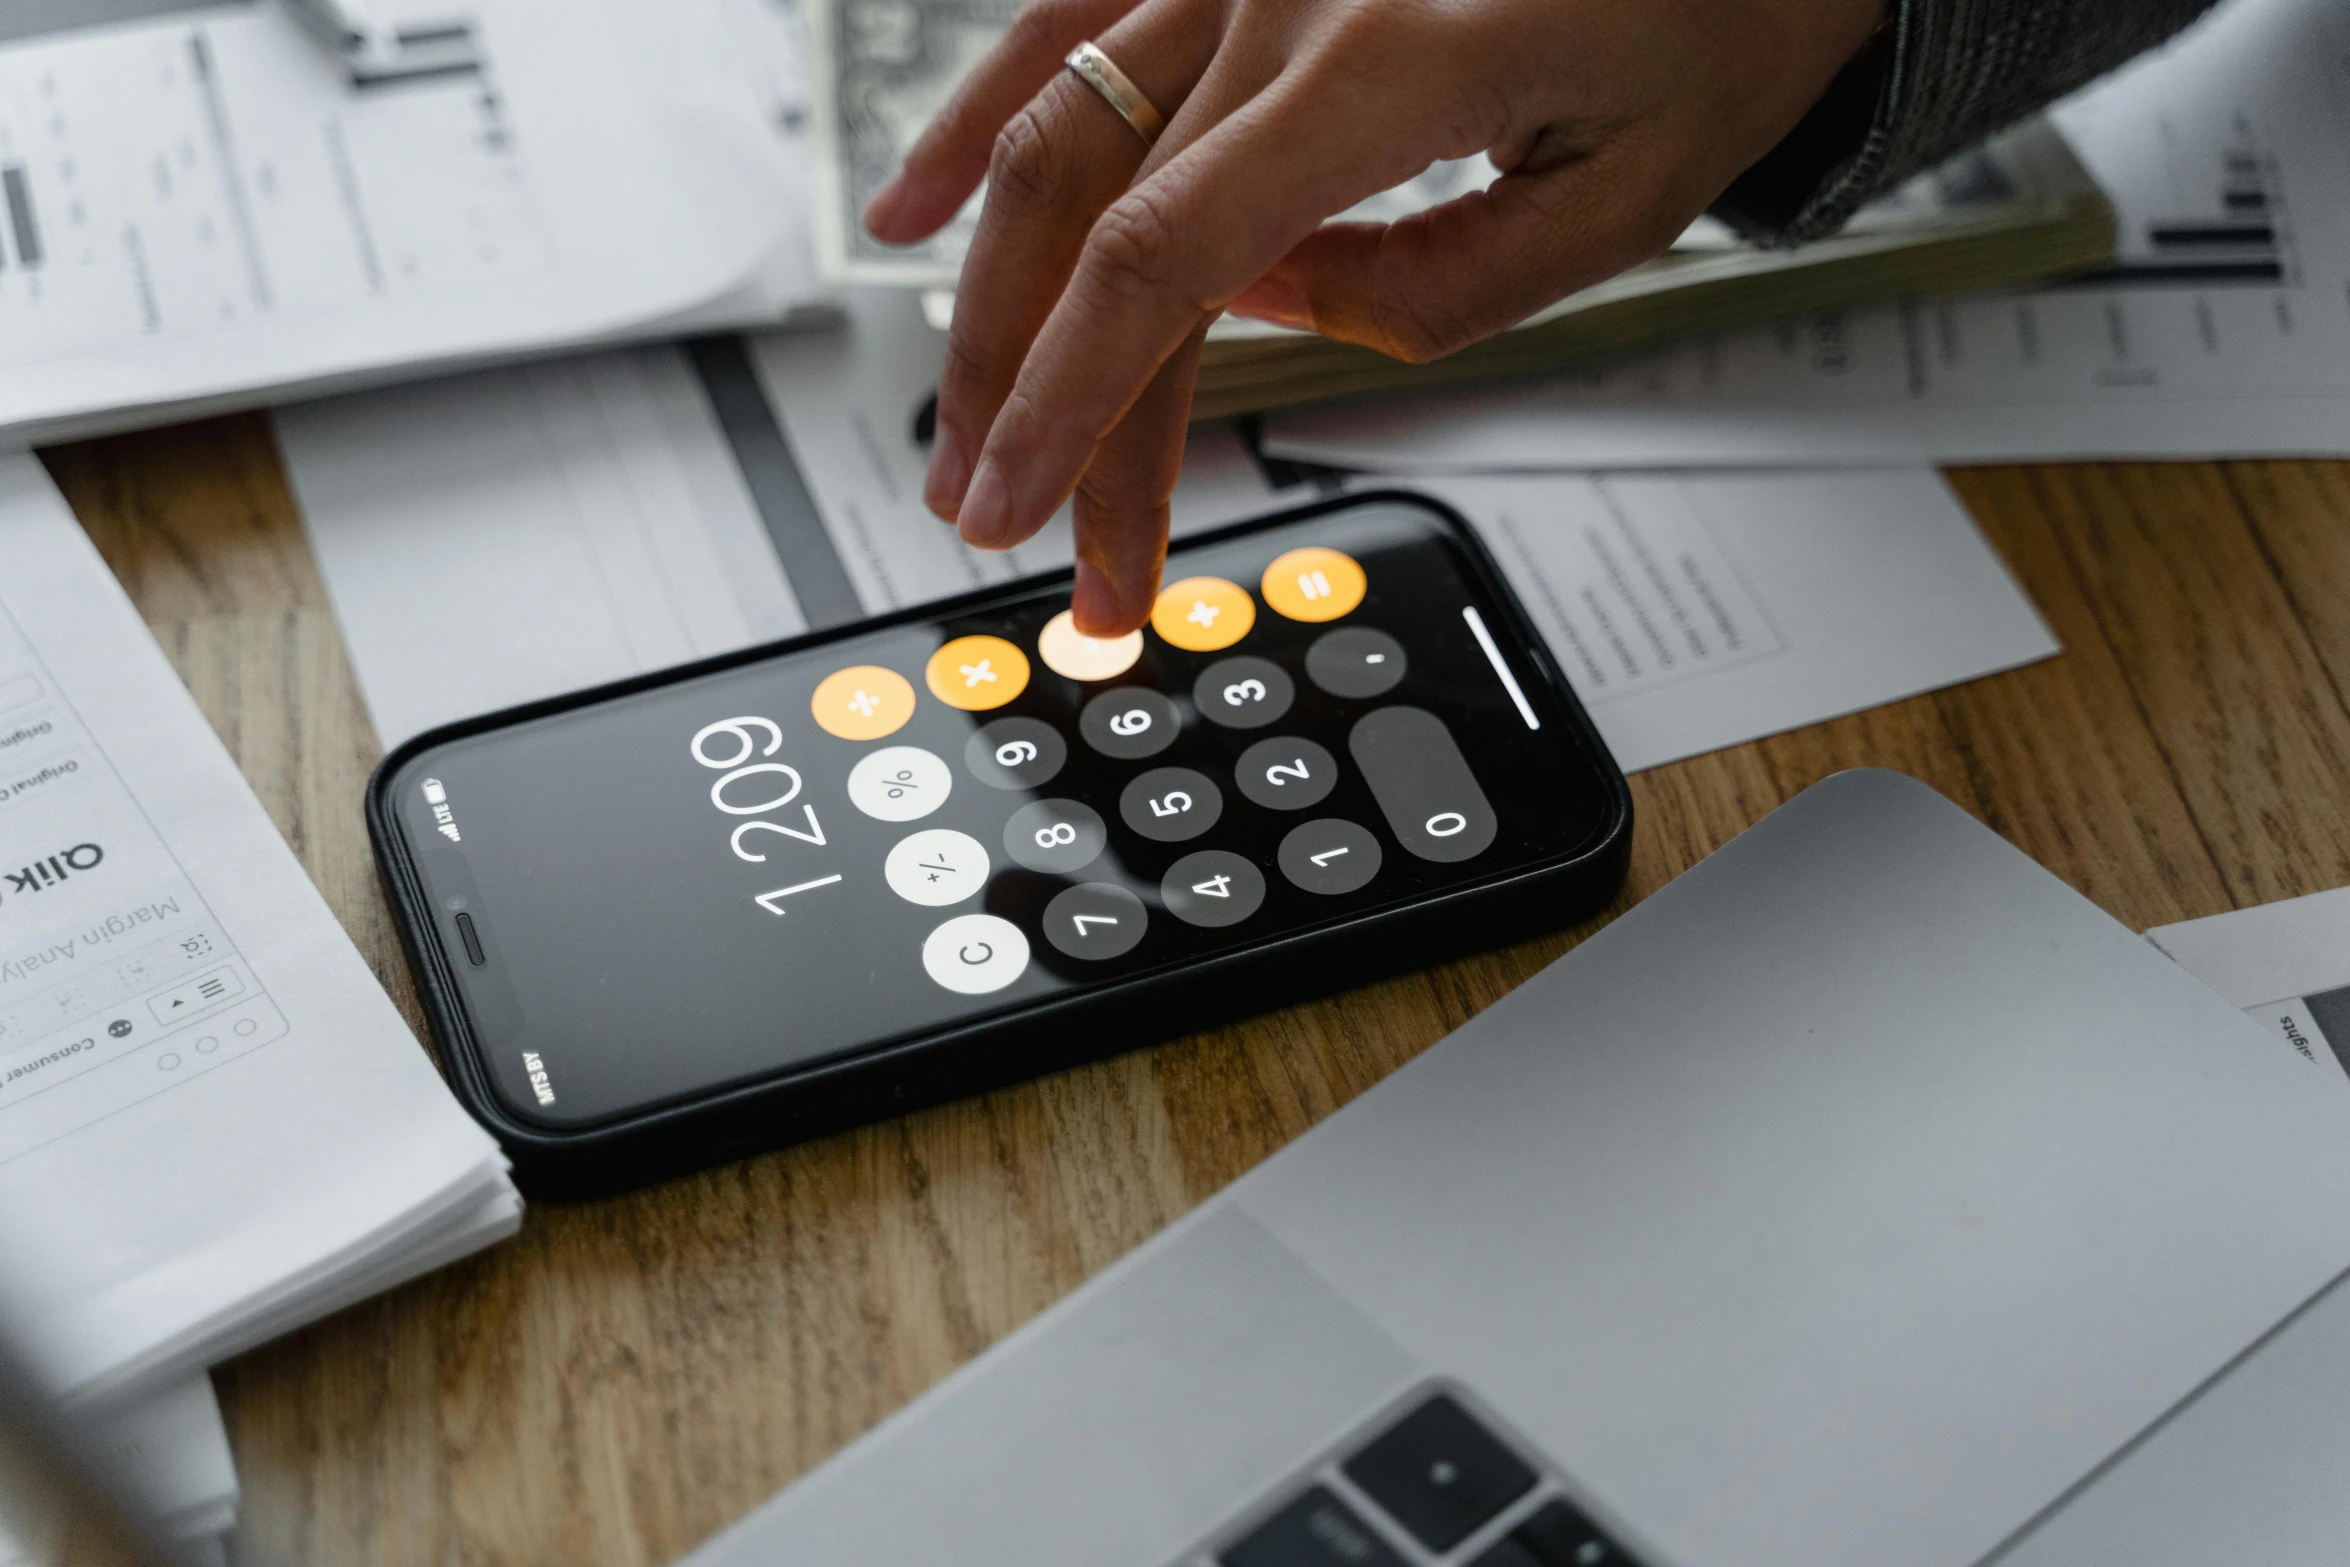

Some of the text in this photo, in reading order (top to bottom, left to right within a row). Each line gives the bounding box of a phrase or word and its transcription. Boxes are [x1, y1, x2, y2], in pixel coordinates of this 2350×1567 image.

[1223, 679, 1266, 706] 3
[0, 721, 53, 749] Origin
[1109, 709, 1152, 736] 6
[995, 740, 1037, 767] 9
[11, 760, 78, 795] Original
[882, 770, 918, 799] %
[1266, 758, 1310, 786] 2
[432, 803, 454, 824] LTE
[1149, 791, 1192, 817] 5
[1034, 822, 1076, 849] 8
[1425, 812, 1467, 837] 0
[3, 843, 104, 890] Qlik
[1309, 847, 1349, 867] 1
[1191, 874, 1231, 899] 4
[82, 896, 181, 945] Margin
[1072, 915, 1118, 937] 7
[959, 942, 994, 966] C
[2280, 1016, 2317, 1065] sights
[6, 1037, 95, 1082] Consumer
